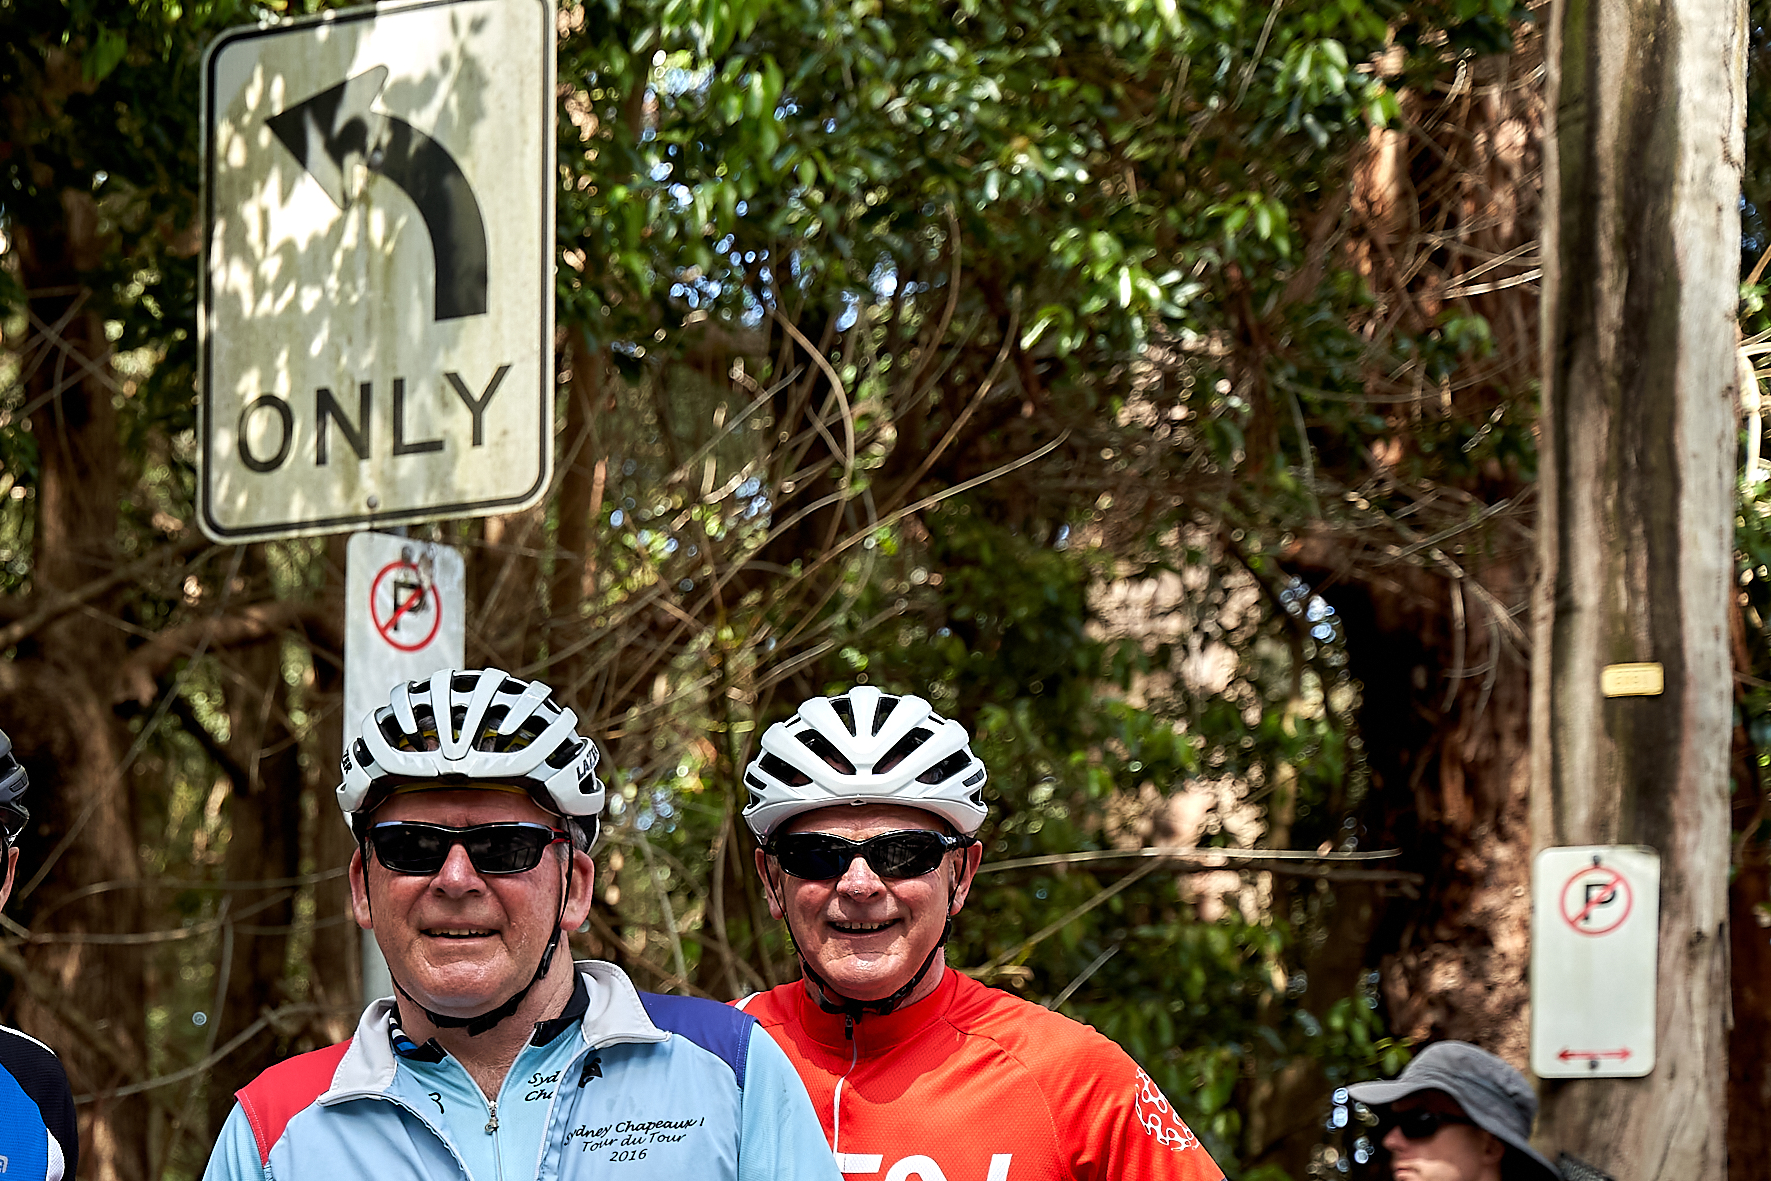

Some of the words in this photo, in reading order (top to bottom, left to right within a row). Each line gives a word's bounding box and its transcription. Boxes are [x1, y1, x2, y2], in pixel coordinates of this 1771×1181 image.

[237, 365, 512, 473] ONLY
[392, 579, 424, 632] P
[1583, 882, 1617, 921] P
[563, 1124, 613, 1147] Sydney
[582, 1136, 618, 1152] Tour
[621, 1133, 646, 1147] du
[648, 1130, 687, 1145] Tour
[609, 1149, 647, 1162] 2016
